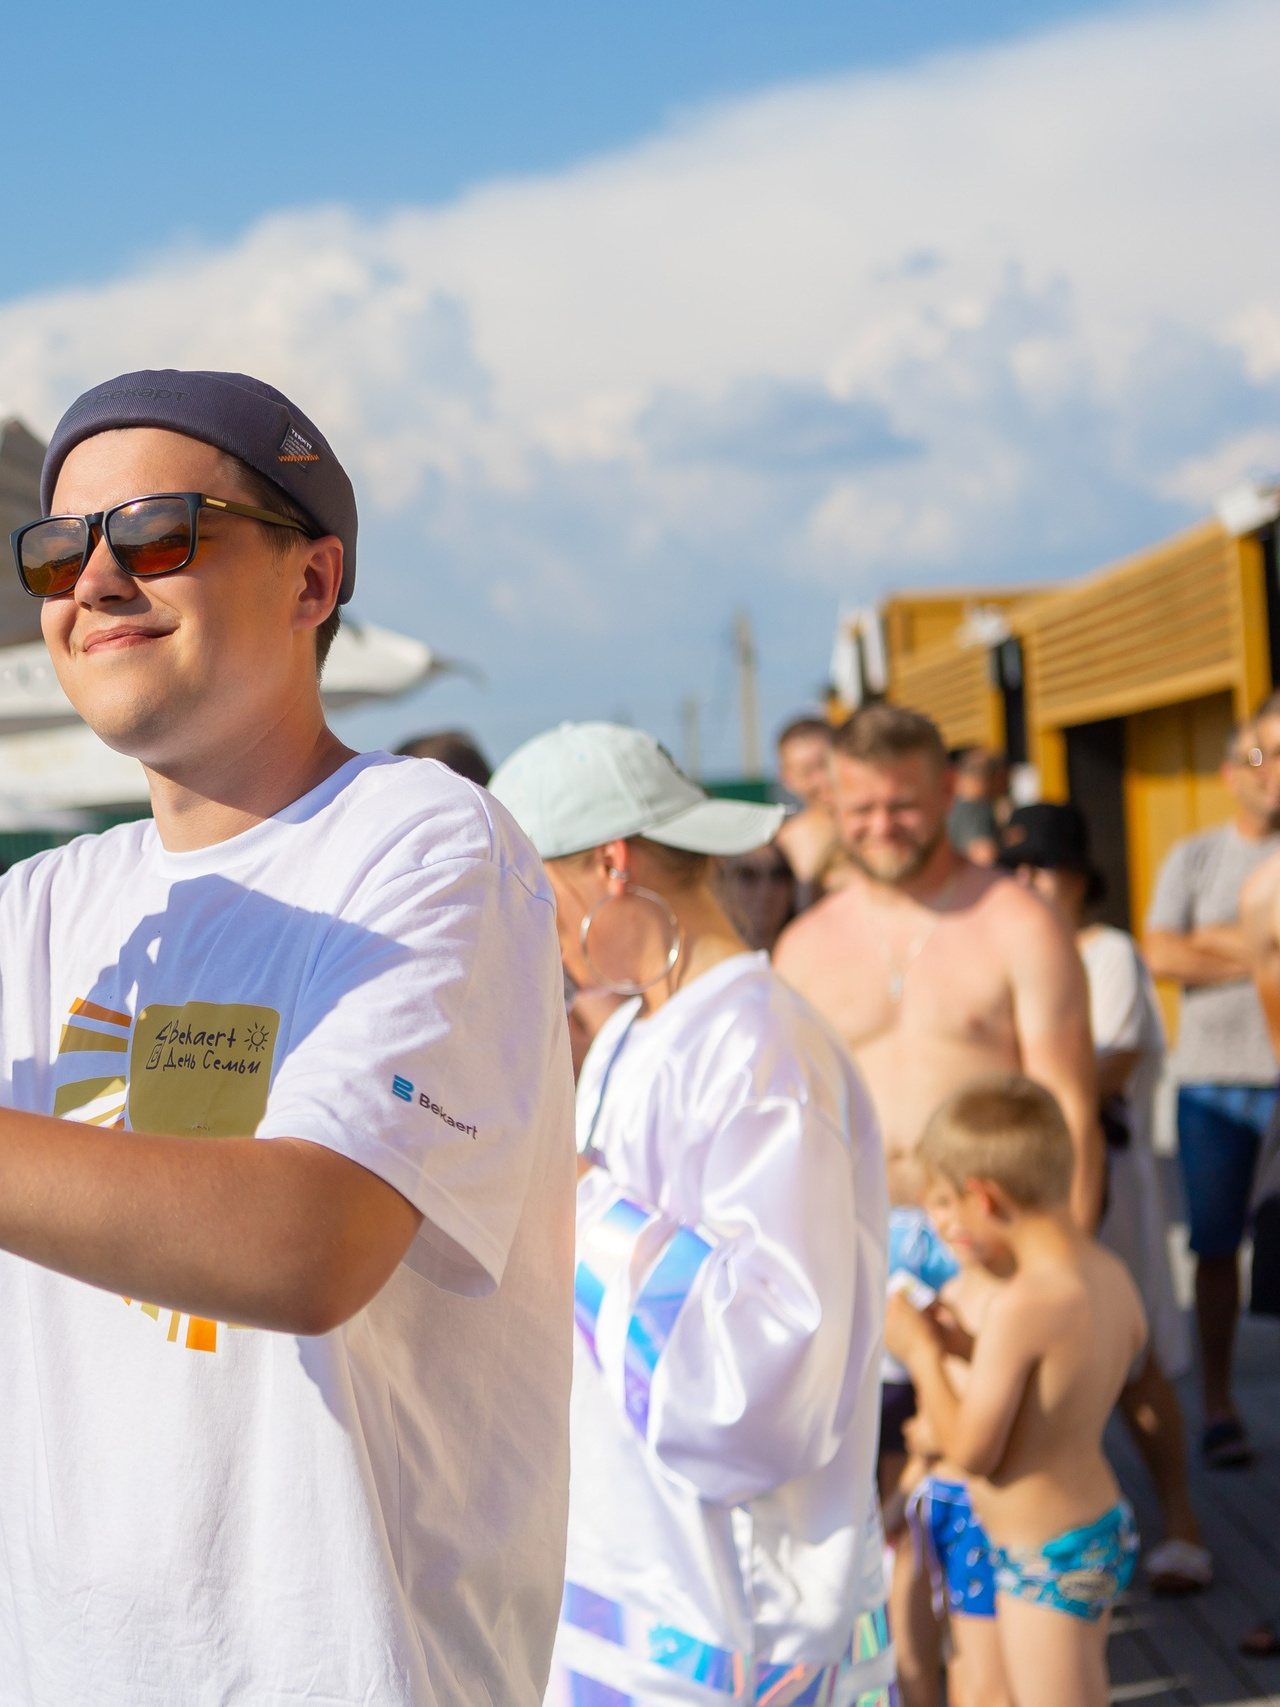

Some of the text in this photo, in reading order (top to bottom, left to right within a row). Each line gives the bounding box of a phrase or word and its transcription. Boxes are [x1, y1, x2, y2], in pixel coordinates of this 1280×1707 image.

[168, 1019, 236, 1048] Bekaert
[162, 1047, 261, 1074] День Семьи
[418, 1092, 478, 1140] Bekaert
